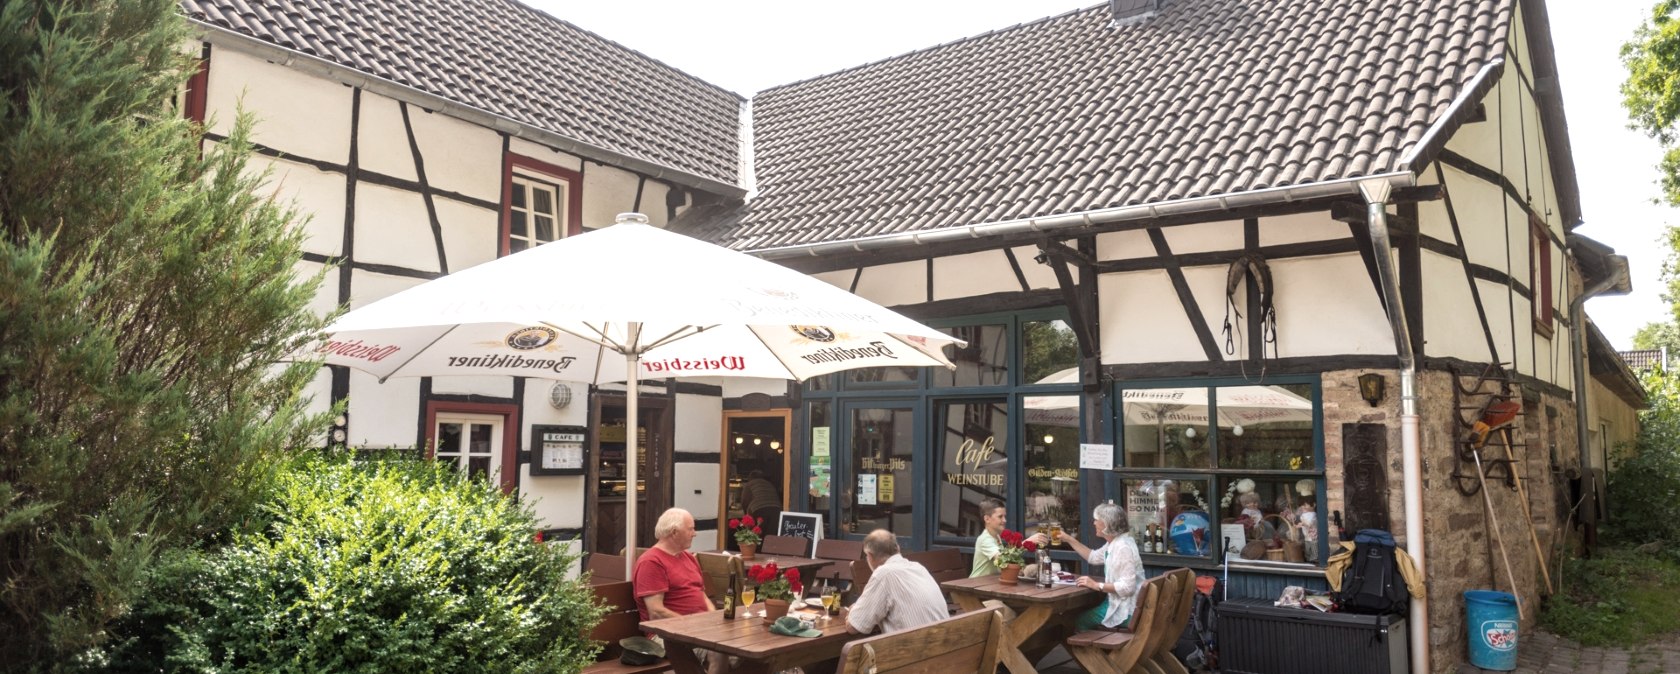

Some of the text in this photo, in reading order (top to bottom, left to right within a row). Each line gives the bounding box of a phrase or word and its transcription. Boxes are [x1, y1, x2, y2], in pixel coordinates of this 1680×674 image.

[889, 457, 906, 473] Pils
[947, 473, 1004, 486] WEINSTUBE
[1129, 497, 1161, 505] HIMME
